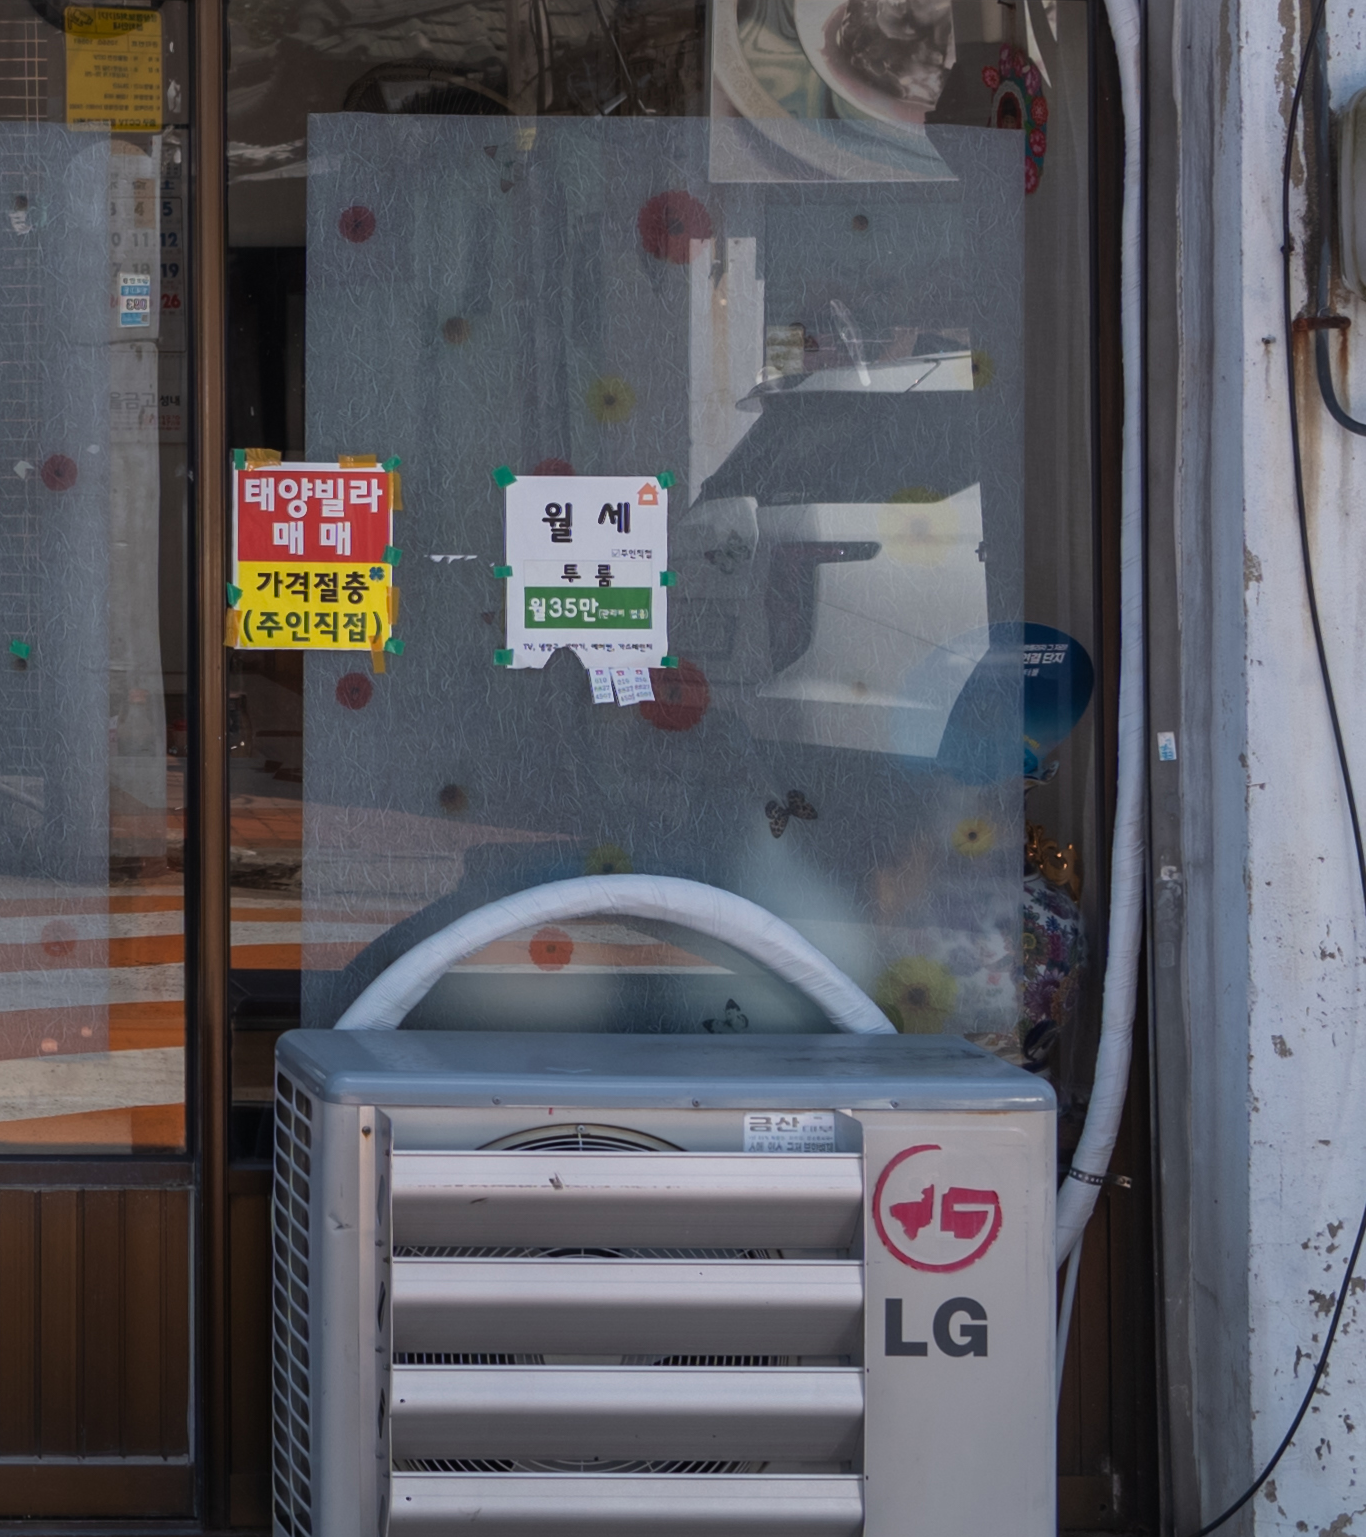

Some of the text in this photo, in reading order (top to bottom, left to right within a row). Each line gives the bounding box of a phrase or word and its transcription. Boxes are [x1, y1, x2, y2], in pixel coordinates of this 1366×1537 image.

[162, 201, 173, 217] 5
[160, 232, 178, 247] 12
[160, 262, 179, 278] 19
[161, 294, 181, 309] 26
[244, 477, 383, 518] 태양빌라
[621, 548, 652, 559] 주인직접
[256, 571, 370, 604] 가격절충
[528, 597, 599, 622] 월35만
[243, 610, 383, 643] (주인직접)
[1042, 652, 1065, 664] 단지
[749, 1116, 800, 1133] 금산
[884, 1296, 989, 1358] LG
